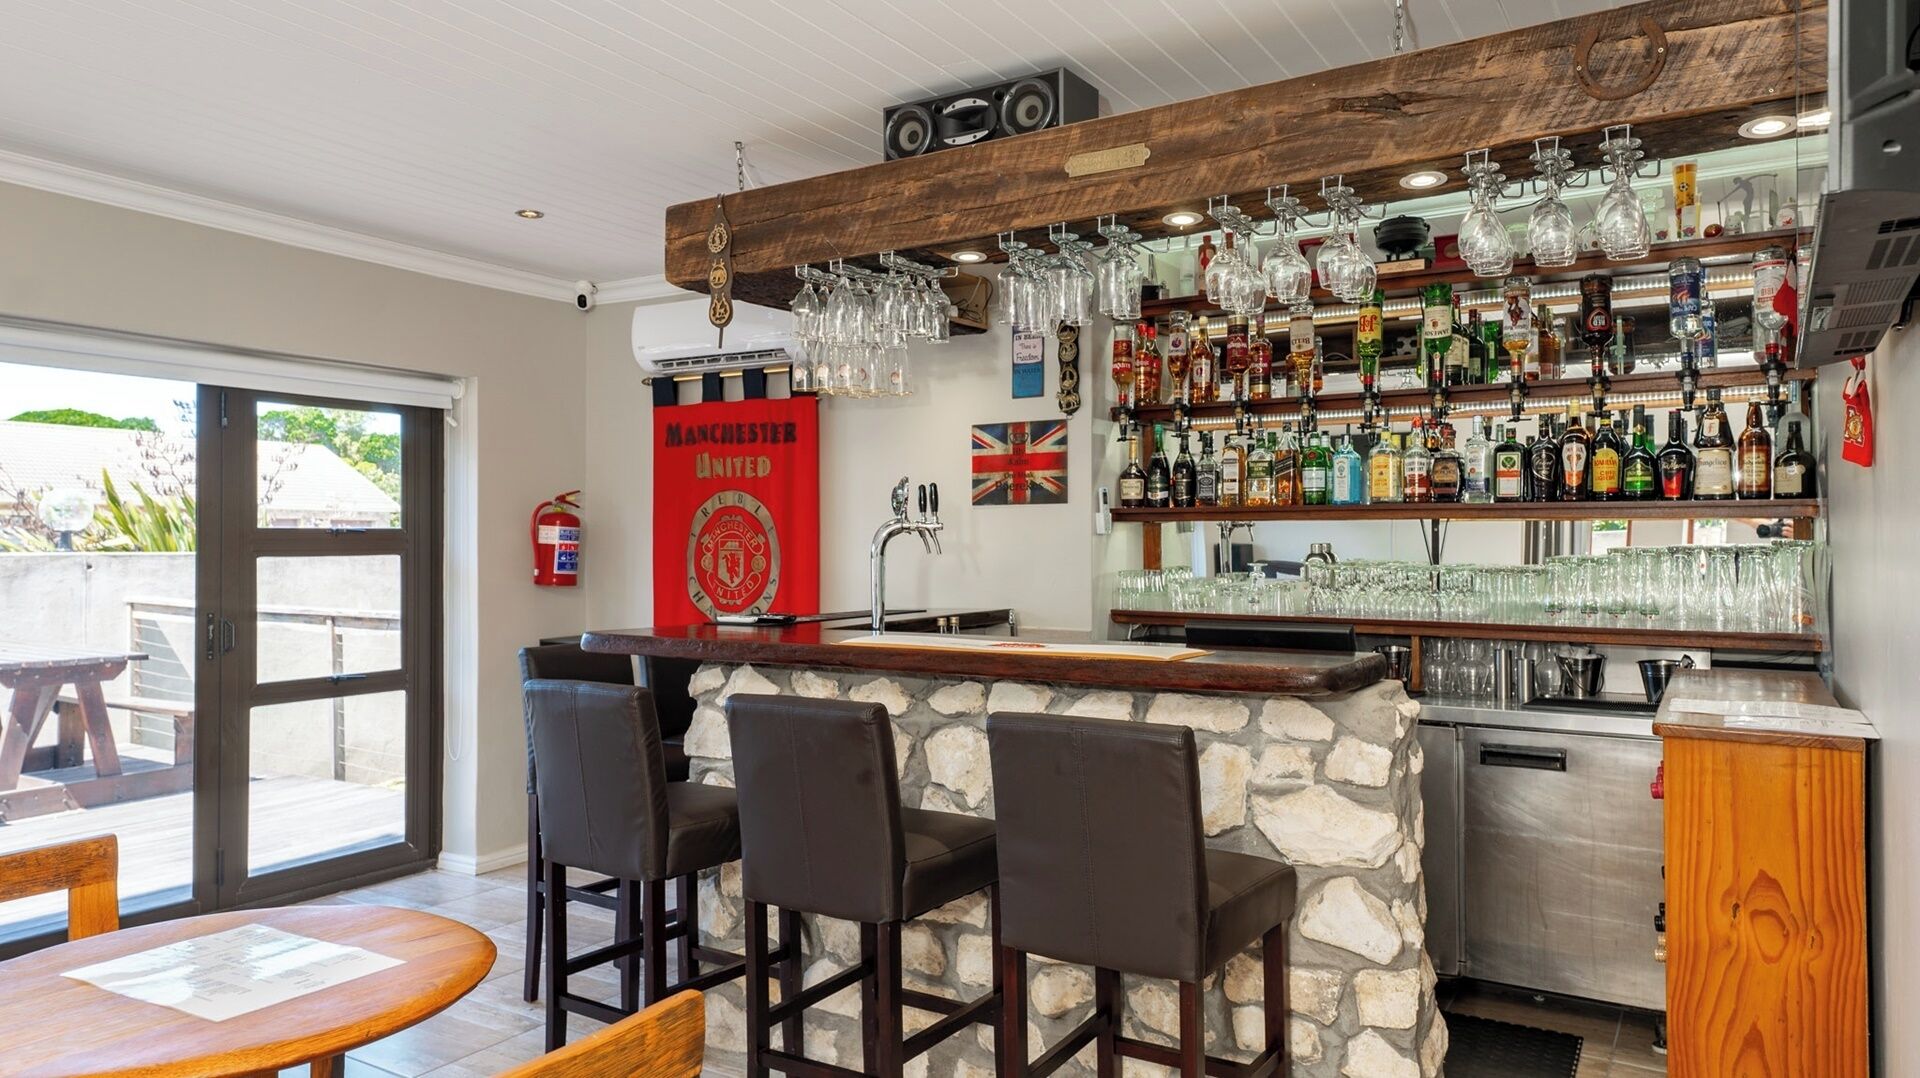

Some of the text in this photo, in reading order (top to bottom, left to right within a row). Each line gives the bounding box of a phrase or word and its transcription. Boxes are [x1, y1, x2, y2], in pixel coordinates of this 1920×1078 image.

[1359, 315, 1377, 332] J&B
[665, 422, 797, 447] MANCHESTER
[696, 452, 772, 479] UNITED
[707, 521, 758, 550] MANCHESTER
